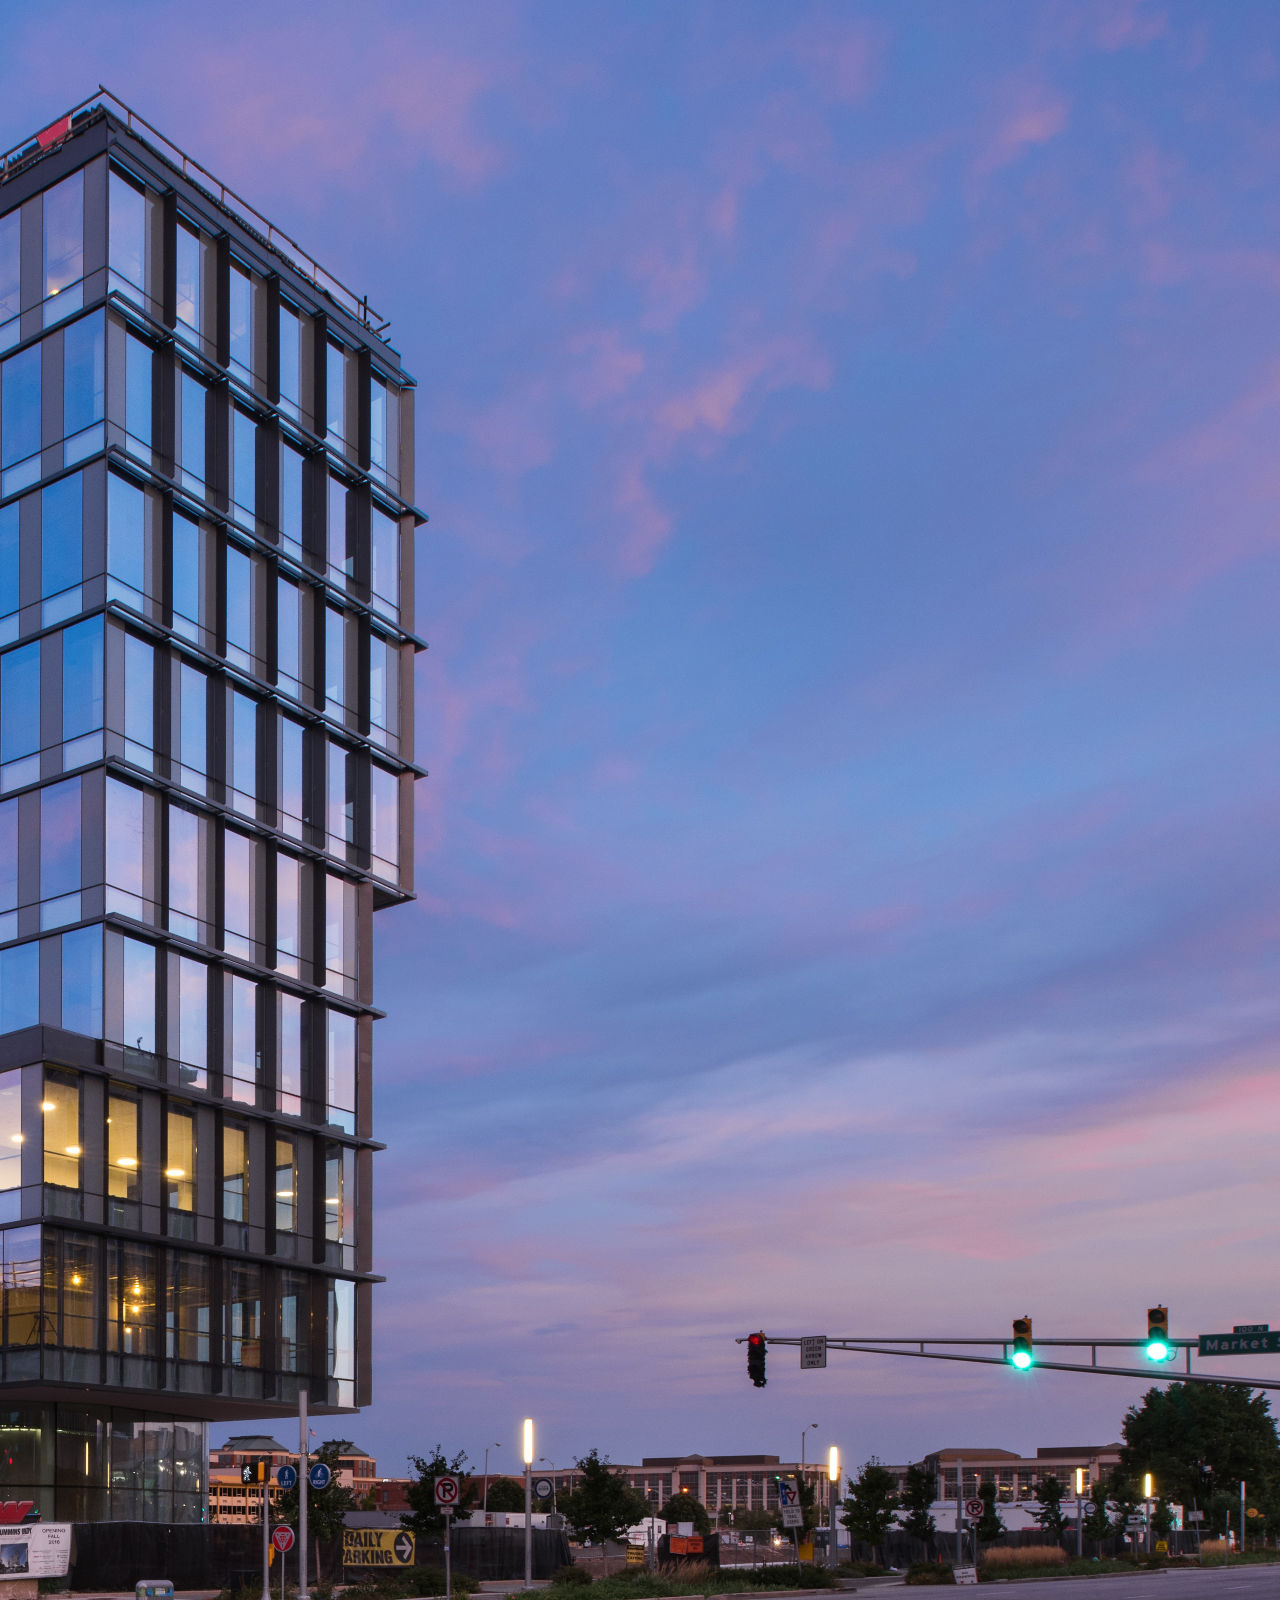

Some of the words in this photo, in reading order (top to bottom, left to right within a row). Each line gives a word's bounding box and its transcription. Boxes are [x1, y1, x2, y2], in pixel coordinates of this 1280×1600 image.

[1206, 1337, 1269, 1351] Market
[344, 1531, 383, 1547] DAILY
[342, 1549, 393, 1564] ARKING
